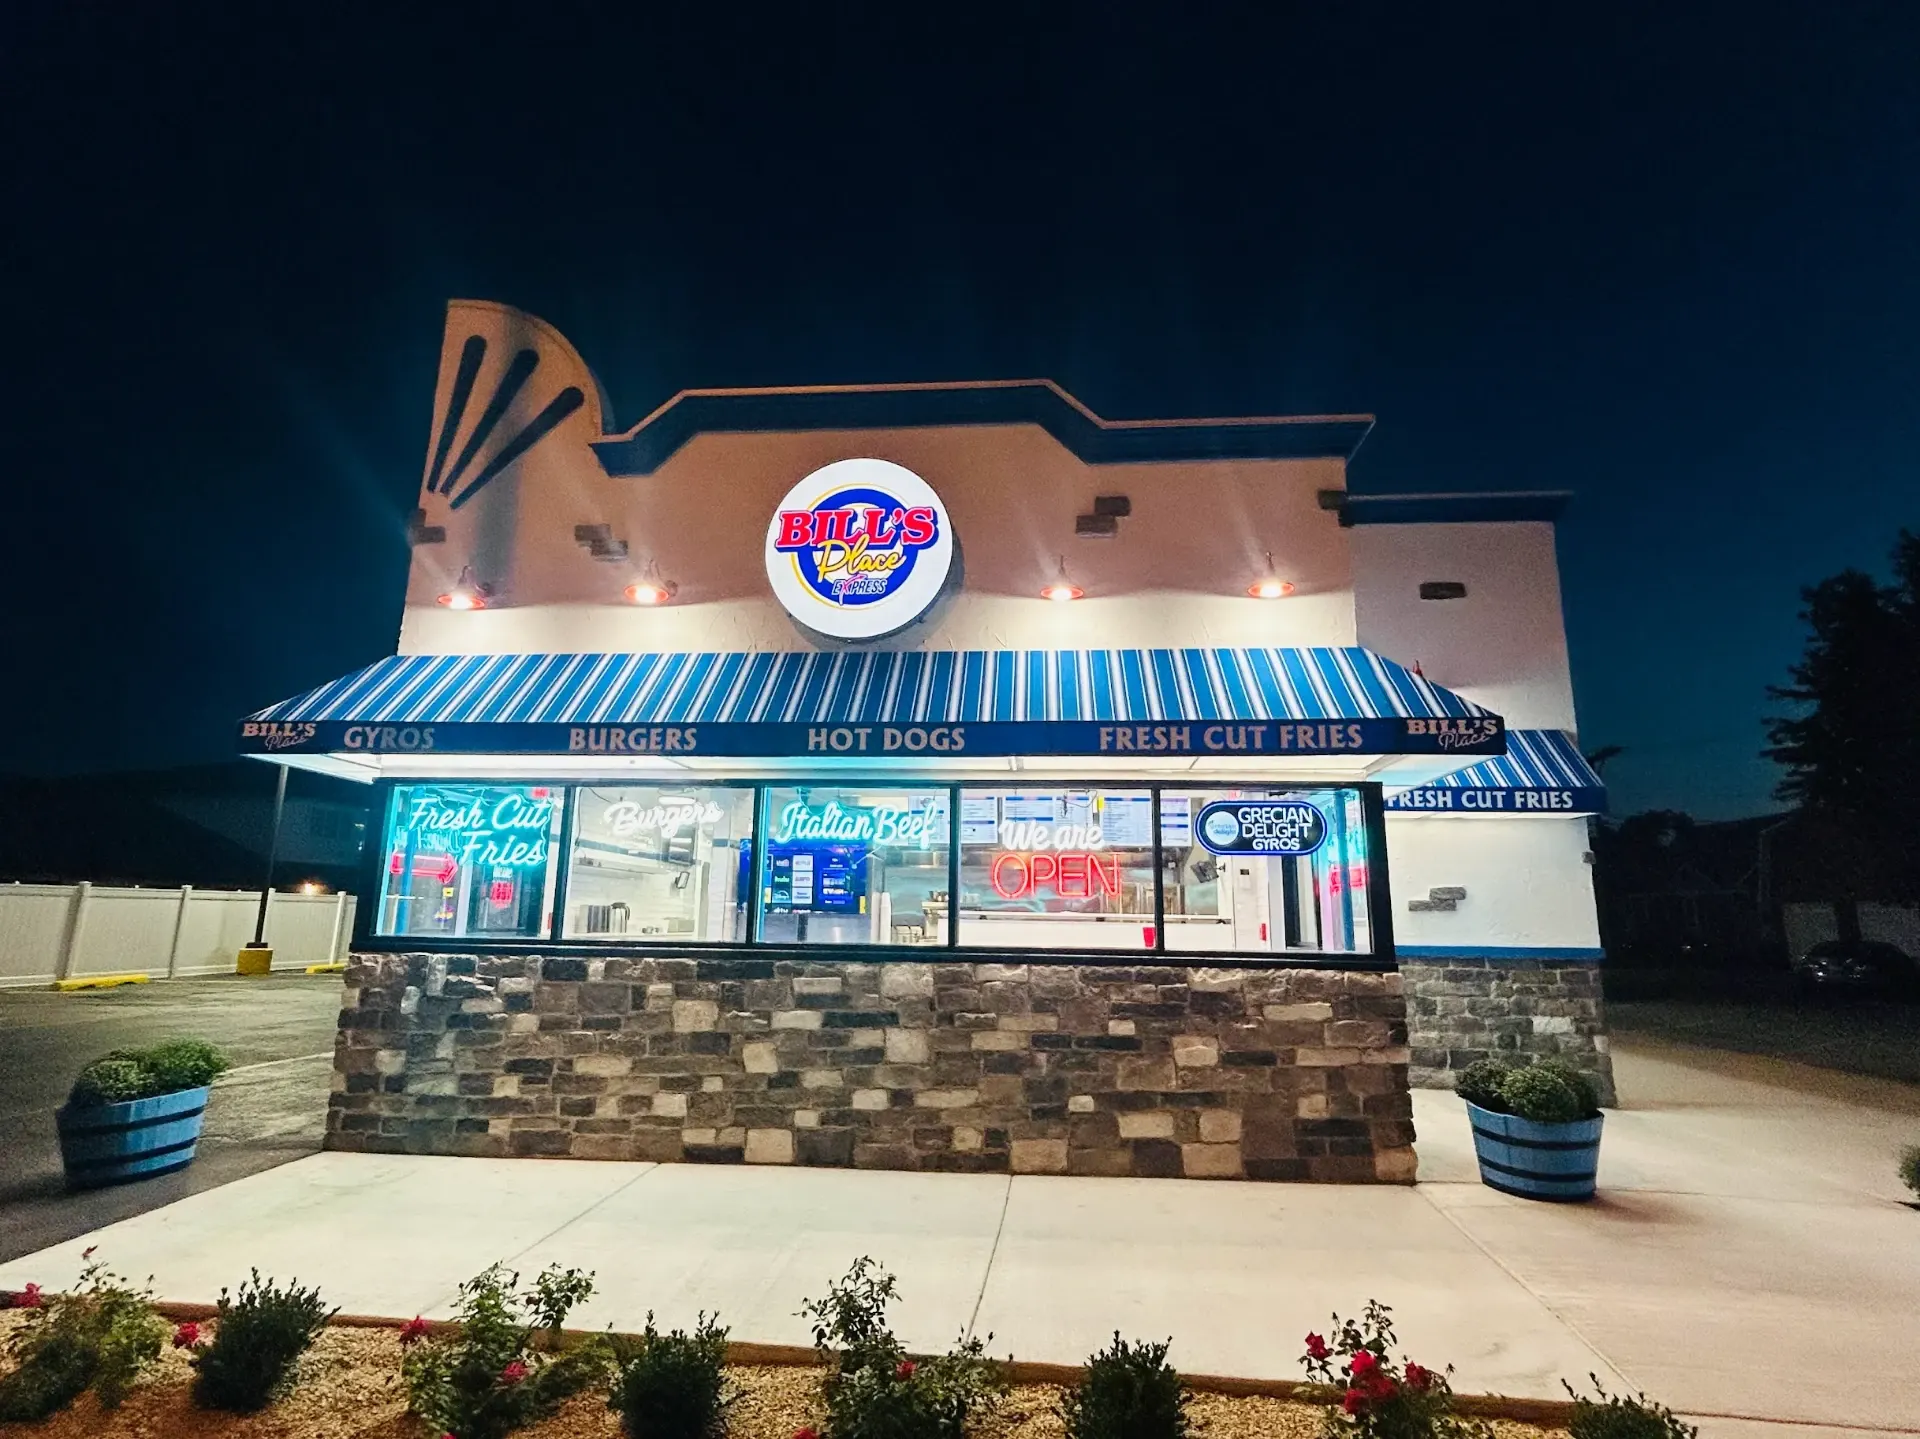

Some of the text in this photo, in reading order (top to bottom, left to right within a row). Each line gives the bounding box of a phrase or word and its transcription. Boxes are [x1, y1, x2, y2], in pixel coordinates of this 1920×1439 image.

[775, 506, 938, 551] BILL'S
[816, 533, 907, 583] Place
[831, 575, 887, 601] EXPRESS
[242, 722, 316, 737] BILL'S
[344, 726, 436, 749] GYROS
[568, 727, 698, 751] BURGERS
[807, 727, 966, 751] HOT DOGS
[1100, 724, 1364, 751] FRESH CUT FRIES
[1407, 719, 1499, 735] BILL'S
[264, 734, 309, 750] Place
[1438, 732, 1491, 750] Place
[1461, 790, 1506, 808] CUT
[1515, 791, 1573, 808] FRIES
[409, 794, 552, 830] Fresh Cut
[603, 801, 724, 838] Burgers
[1237, 807, 1314, 824] GRECIAN
[774, 801, 874, 844] Italian
[872, 800, 938, 849] Beef
[998, 819, 1105, 850] We are
[1242, 822, 1313, 838] DELIGHT
[459, 831, 547, 866] Fries
[1252, 837, 1300, 850] GYROS
[991, 852, 1122, 899] OPEN
